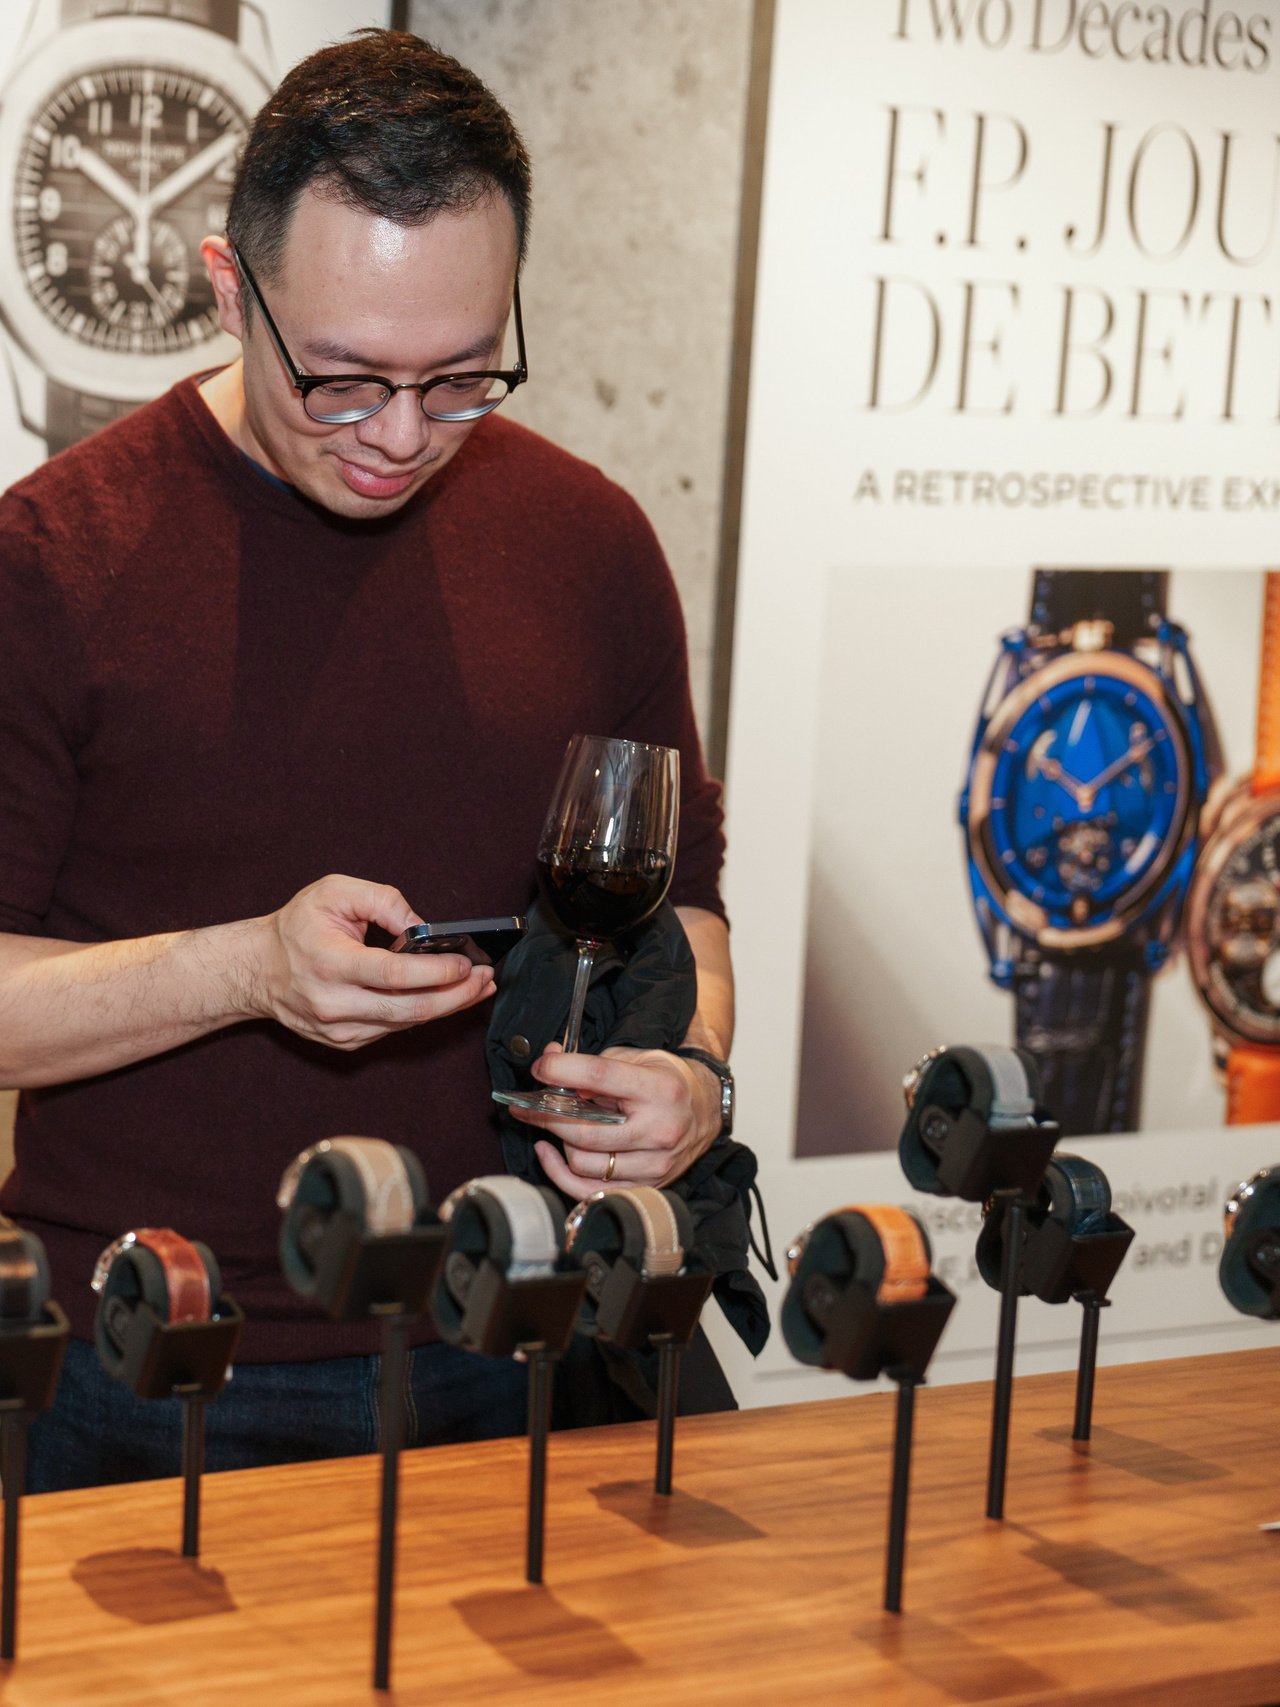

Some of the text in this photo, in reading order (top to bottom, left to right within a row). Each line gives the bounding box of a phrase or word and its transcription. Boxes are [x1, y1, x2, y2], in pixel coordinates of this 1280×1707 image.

[1027, 0, 1272, 74] Decades
[875, 104, 1280, 268] F.P. JOU
[864, 274, 1280, 424] DE BET
[853, 470, 882, 504] A
[892, 469, 1211, 512] RETROSPECTIVE
